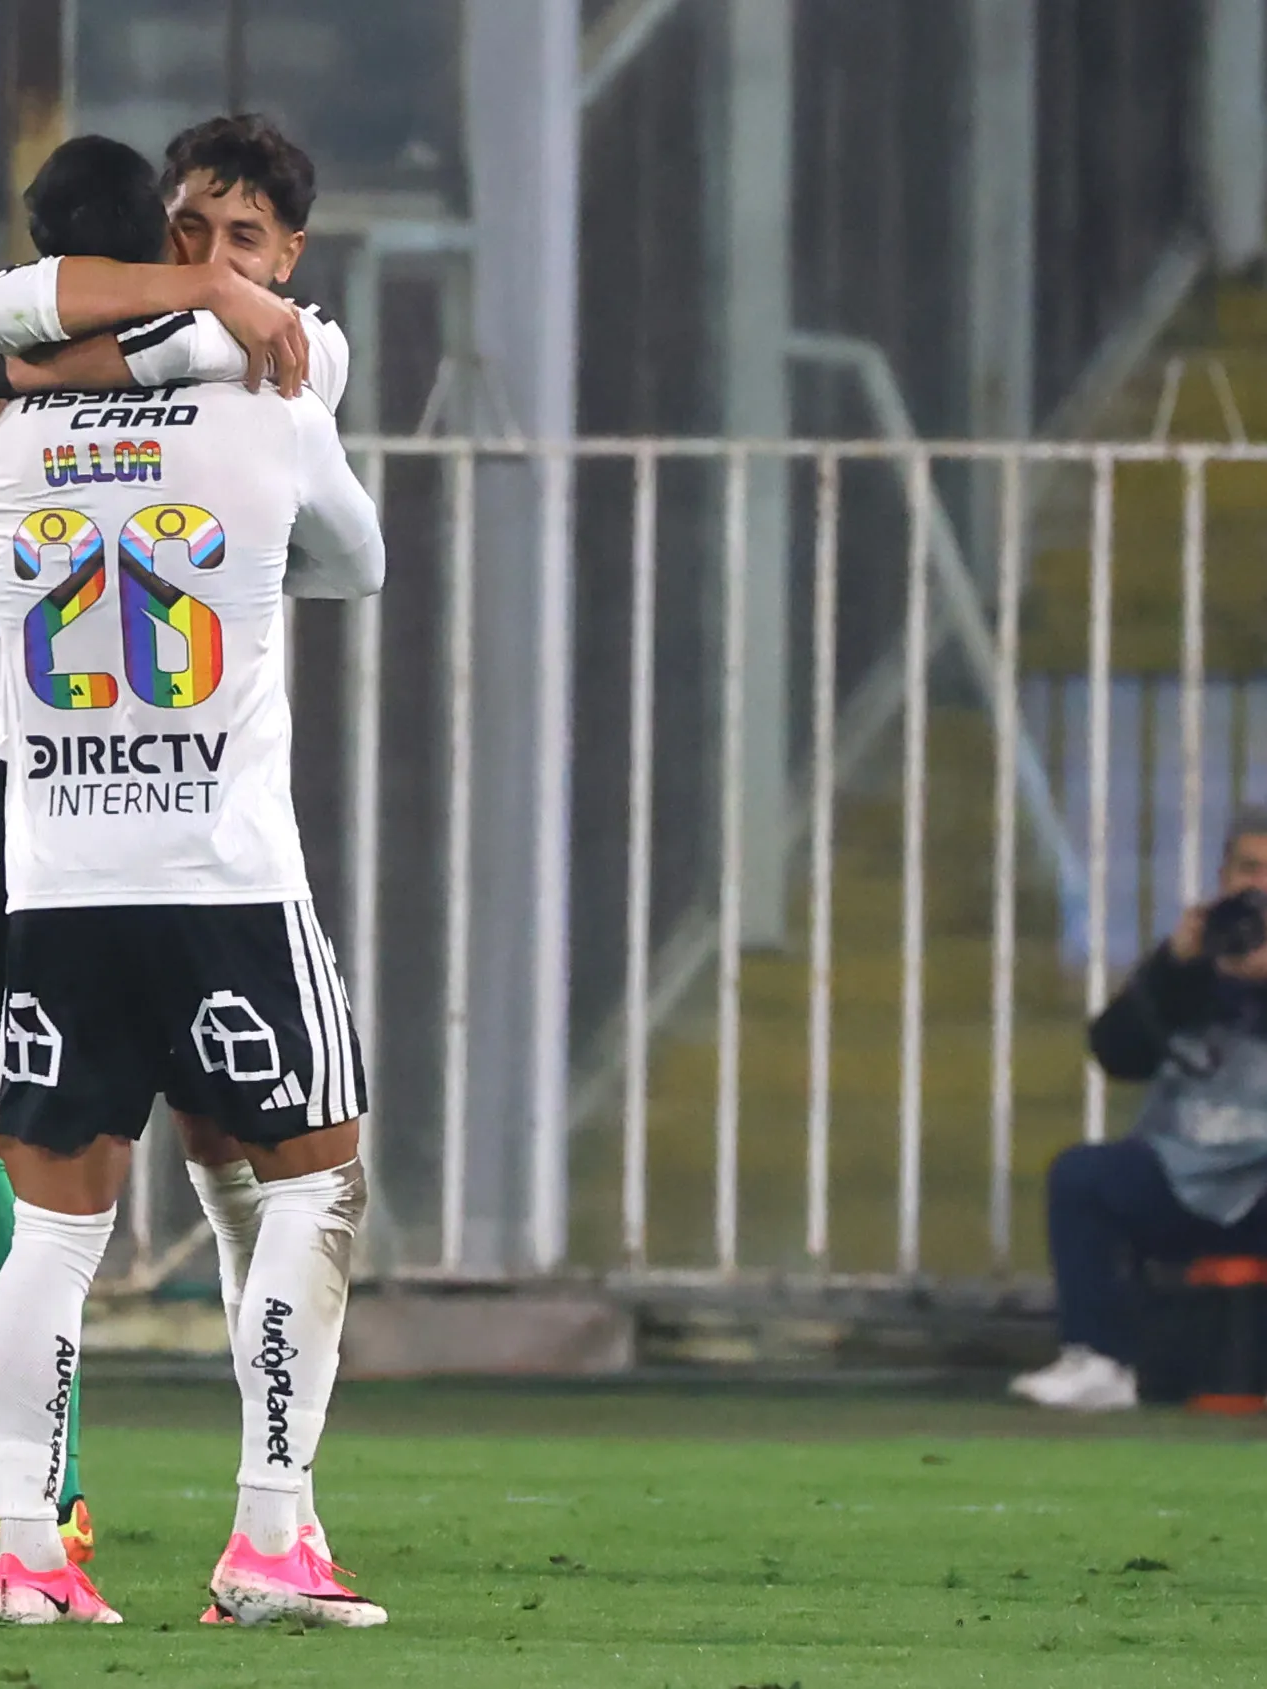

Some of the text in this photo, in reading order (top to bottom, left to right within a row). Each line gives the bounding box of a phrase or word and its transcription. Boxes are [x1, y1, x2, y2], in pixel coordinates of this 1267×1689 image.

[70, 404, 199, 430] CARD
[43, 440, 162, 488] ULLOA
[13, 503, 226, 711] 26
[25, 732, 229, 780] DIRECTV
[49, 781, 220, 818] INTERNET
[251, 1297, 300, 1469] AutoPlanet
